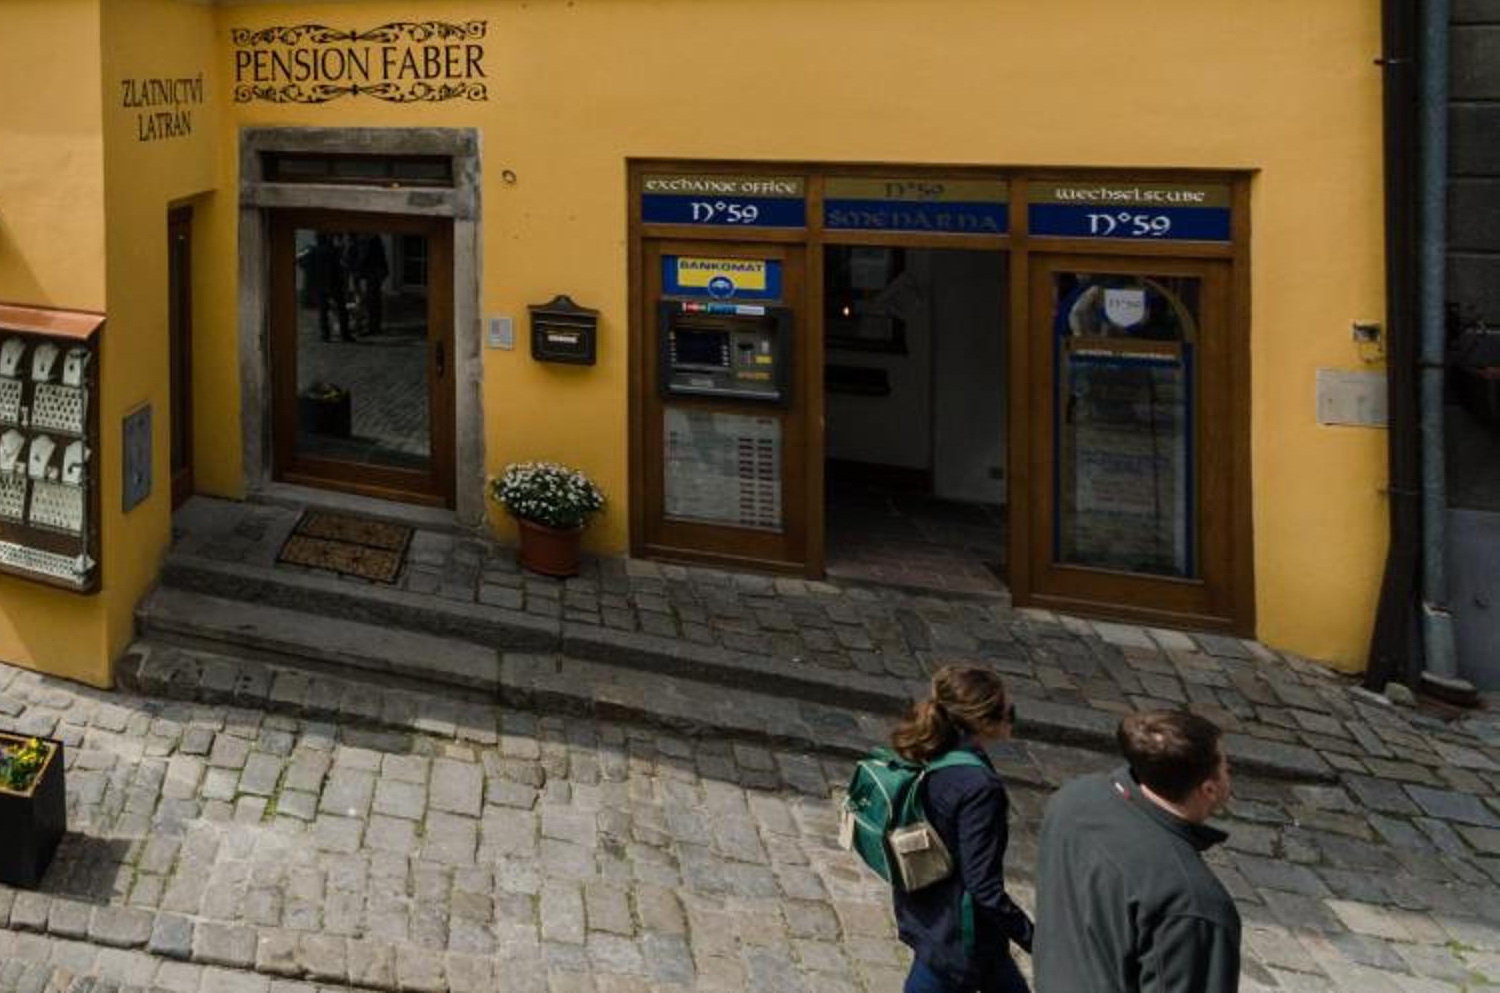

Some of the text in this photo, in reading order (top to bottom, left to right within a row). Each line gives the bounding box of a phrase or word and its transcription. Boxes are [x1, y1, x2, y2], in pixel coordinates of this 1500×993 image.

[235, 44, 486, 82] PENSION FABER
[121, 72, 204, 107] ZLATNICTVÍ
[137, 107, 192, 142] LATRÁN
[679, 261, 763, 273] BANKOMAT
